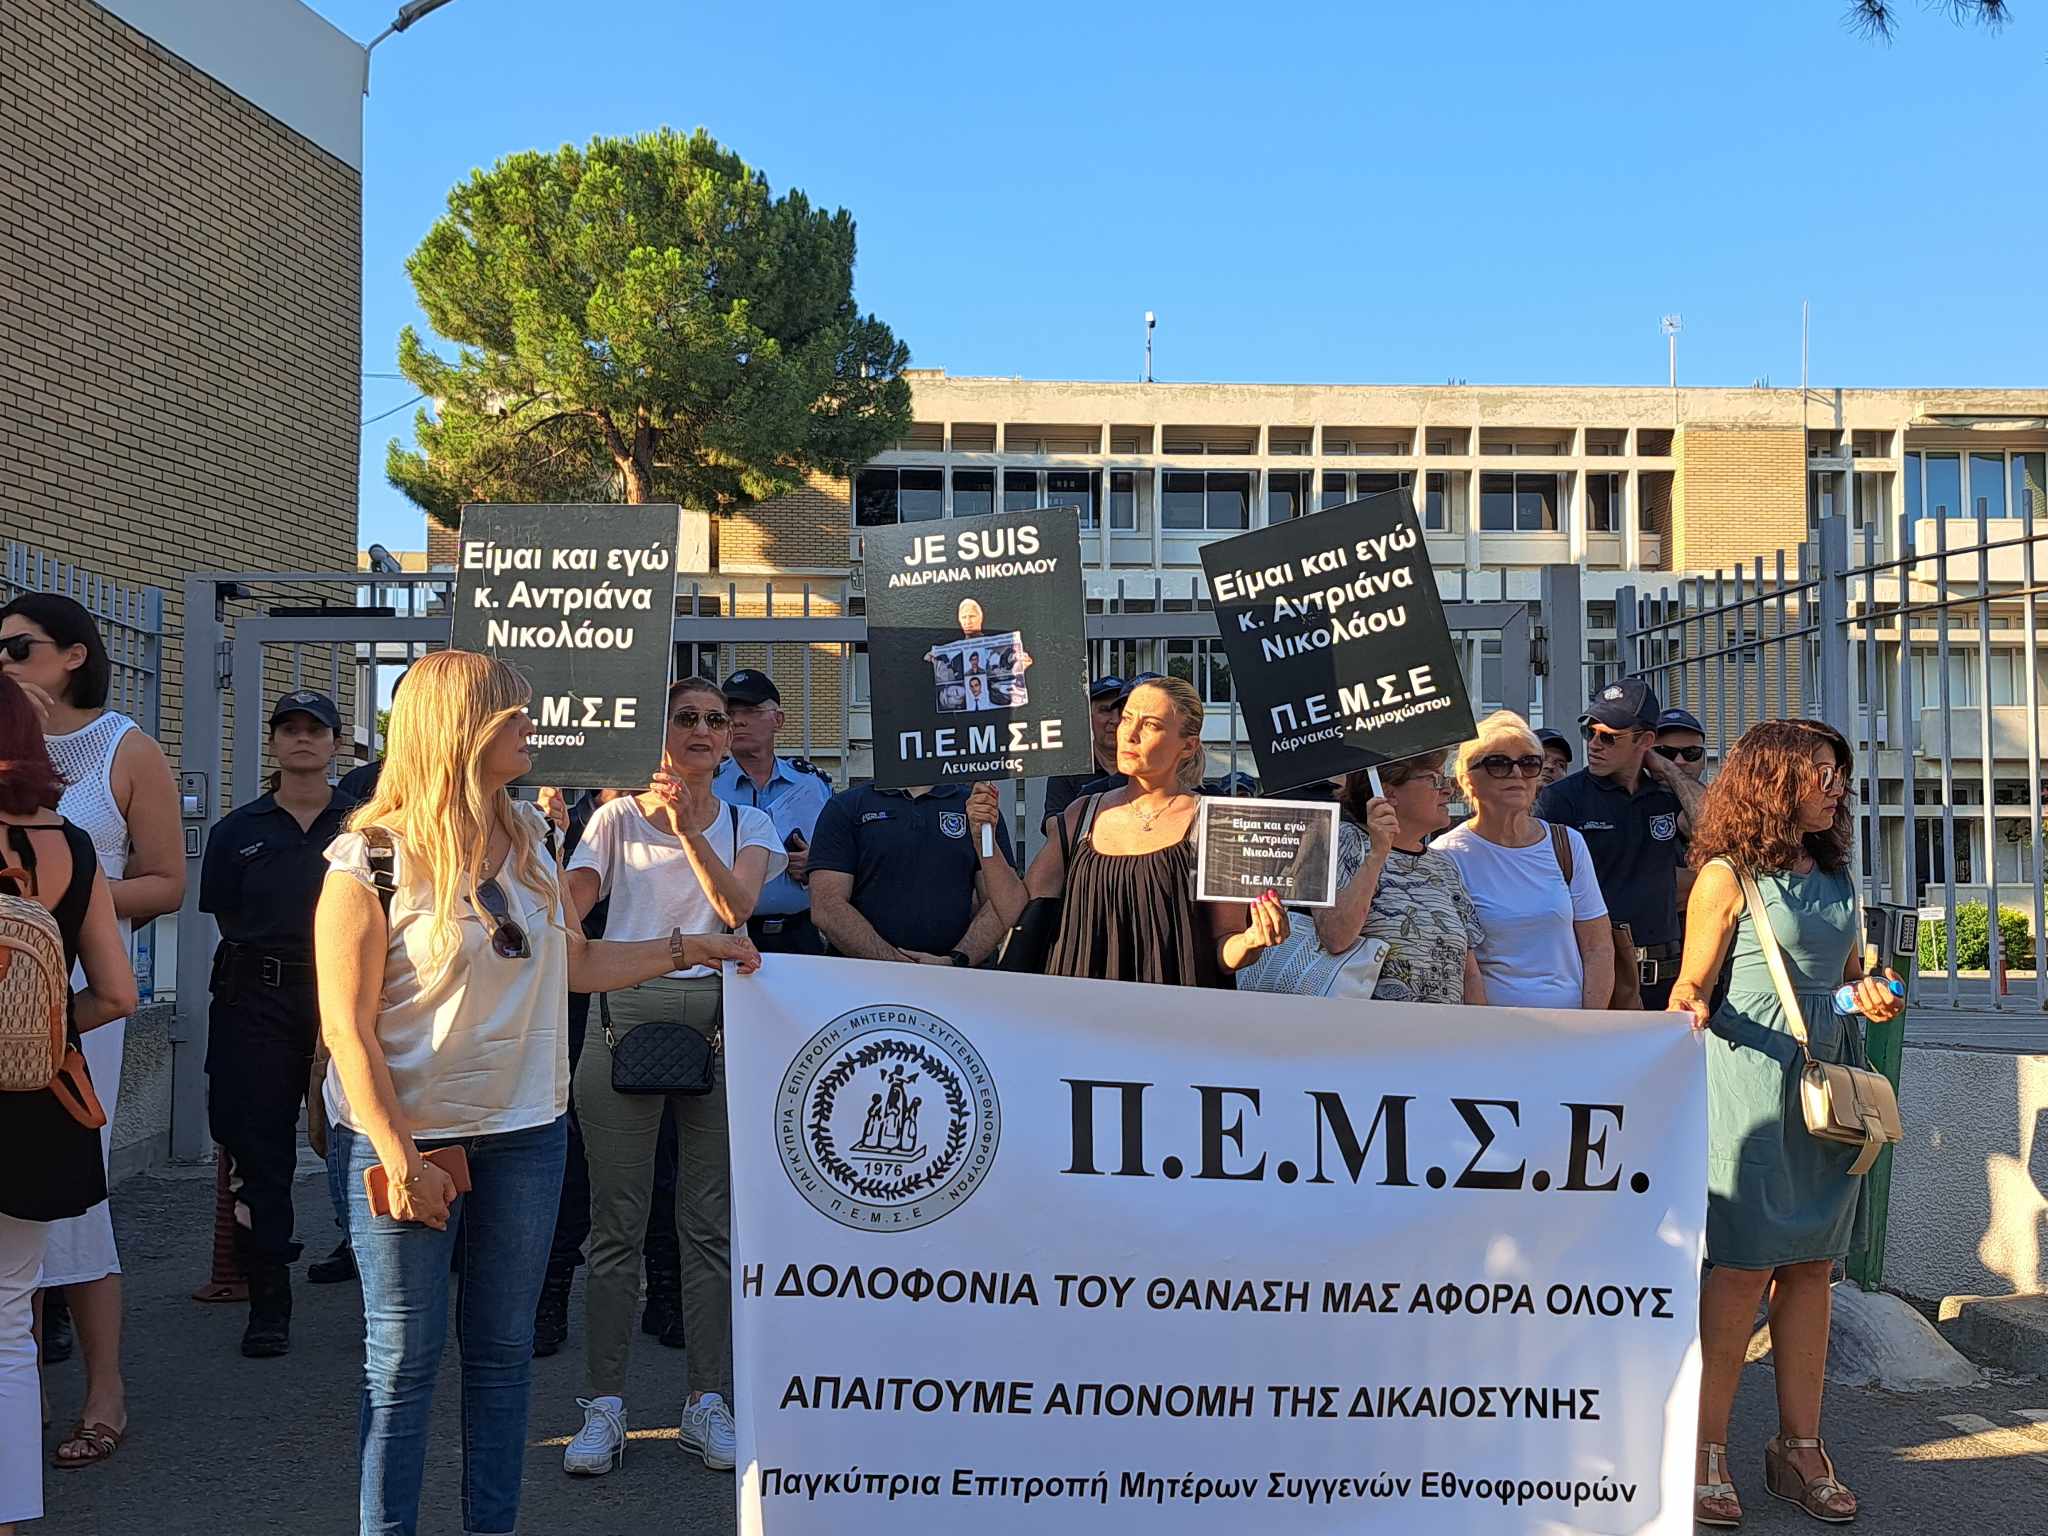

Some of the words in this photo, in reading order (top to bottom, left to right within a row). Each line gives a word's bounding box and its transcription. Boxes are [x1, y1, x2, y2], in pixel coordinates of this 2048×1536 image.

[463, 541, 541, 576] Είμαι
[552, 549, 596, 570] και
[607, 541, 669, 577] εγώ
[904, 535, 945, 566] JE
[958, 526, 1040, 560] SUIS
[1213, 563, 1294, 602] Είμαι
[1301, 546, 1347, 578] και
[1355, 523, 1417, 562] εγώ
[888, 570, 971, 589] ΑΝΔΡΙΑΝΑ
[975, 558, 1058, 580] ΝΙΚΟΛΑΟΥ
[474, 586, 499, 608] κ.
[507, 580, 652, 615] Αντριάνα
[1237, 610, 1265, 632] κ.
[1273, 565, 1414, 624] Αντριάνα
[487, 620, 634, 649] Νικολάου
[1260, 605, 1407, 662] Νικολάου
[520, 696, 637, 729] .Μ.Σ.Ε
[1270, 665, 1437, 734] Π.Ε.Μ.Σ.Ε
[900, 719, 1063, 760] Π.Ε.Μ.Σ.Ε
[1271, 724, 1344, 753] Λάρνακας
[1355, 696, 1451, 732] Αμμοχώστου
[942, 757, 1023, 775] Λευκωσίας
[1232, 818, 1261, 831] Είμαι
[1263, 822, 1281, 831] και
[1284, 821, 1306, 834] εγώ
[1251, 834, 1300, 846] Αντριάνα
[1242, 847, 1293, 858] Νικολάου
[850, 1011, 917, 1030] ΜΗΤΕΡΩΝ
[788, 1029, 841, 1095] ΕΠΙΤΡΟΠΗ
[928, 1023, 985, 1085] ΣΥΓΓΕΝΩΝ
[783, 1108, 817, 1192] ΠΑΓΚΥΠΡΙΑ
[949, 1088, 994, 1201] ΕΘΝΟΦΡΟΥΡΩΝ
[1060, 1078, 1650, 1194] Π.Ε.Μ.Σ.Ε.
[864, 1163, 903, 1177] 1976
[743, 1263, 763, 1298] Η
[775, 1263, 1039, 1306] ΔΟΛΟΦΟΝΙΑ
[1053, 1274, 1135, 1309] ΤΟΥ
[1146, 1277, 1309, 1313] ΘΑΝΑΣΗ
[1322, 1281, 1400, 1314] ΜΑΣ
[1408, 1282, 1535, 1316] ΑΦΟΡΑ
[1546, 1284, 1674, 1319] ΟΛΟΥΣ
[779, 1375, 1034, 1415] ΑΠΑΙΤΟΥΜΕ
[1043, 1382, 1254, 1417] ΑΠΟΝΟΜΗ
[1267, 1385, 1339, 1418] ΤΗΣ
[1348, 1386, 1601, 1421] ΔΙΚΑΙΟΣΥΝΗΣ
[761, 1466, 941, 1501] Παγκύπρια
[951, 1469, 1108, 1504] Επιτροπή
[1120, 1471, 1258, 1505] Μητέρων
[1267, 1472, 1411, 1505] Συγγενών
[1421, 1471, 1637, 1508] Εθνοφρουρών
